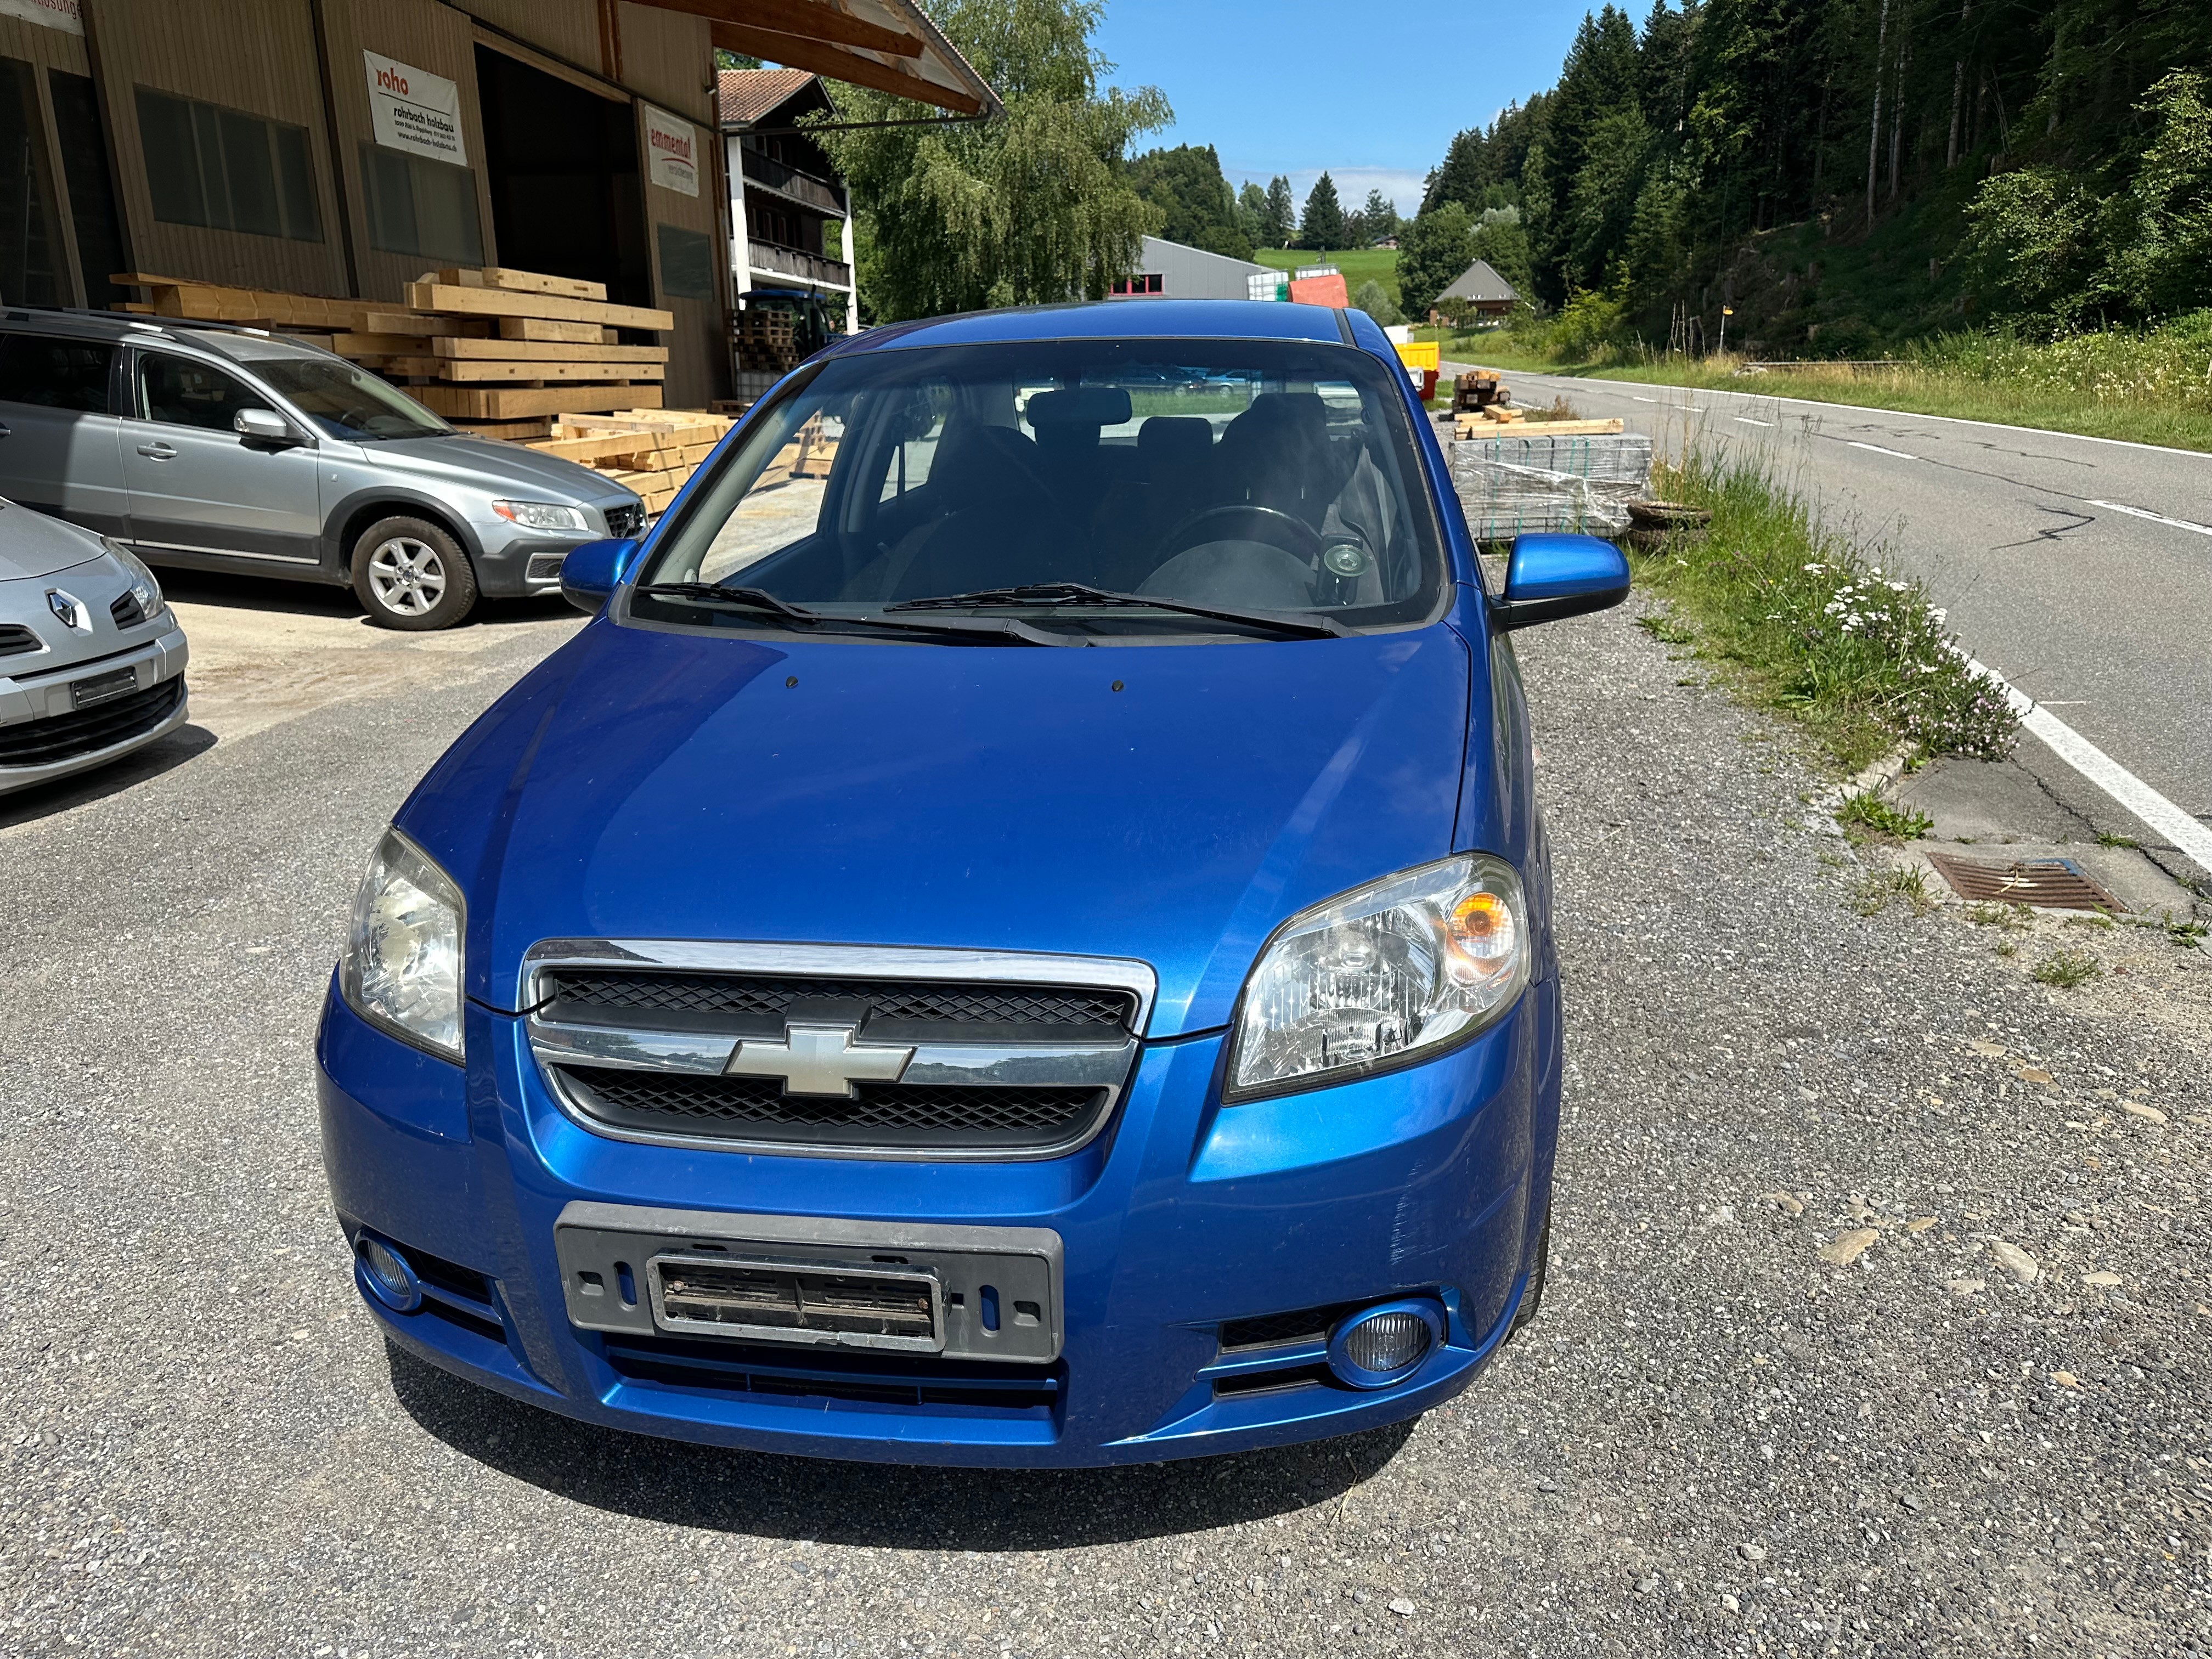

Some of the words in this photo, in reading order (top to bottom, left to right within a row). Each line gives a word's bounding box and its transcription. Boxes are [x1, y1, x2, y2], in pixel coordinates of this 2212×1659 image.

[376, 67, 409, 95] roho
[394, 106, 425, 125] rohrbach
[427, 114, 454, 133] holzbau
[651, 128, 691, 159] emmental
